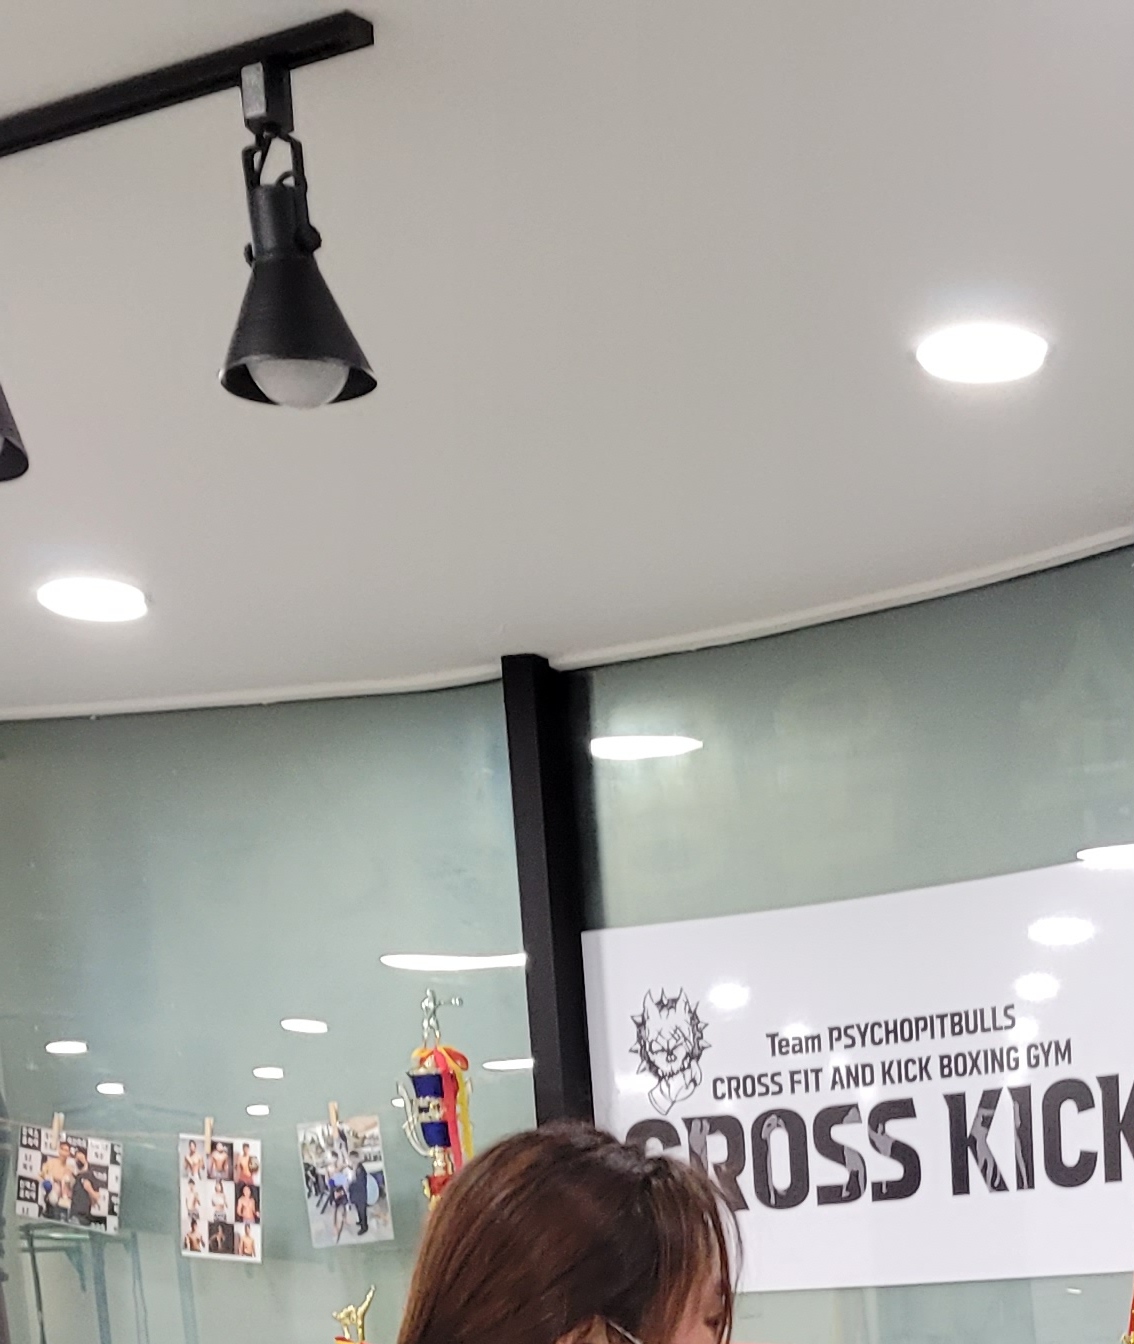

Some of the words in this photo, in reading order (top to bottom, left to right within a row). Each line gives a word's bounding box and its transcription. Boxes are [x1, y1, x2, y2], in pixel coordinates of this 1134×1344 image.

[766, 1031, 822, 1057] Team
[828, 1004, 1017, 1051] PSYCHOPITBULLS
[711, 1070, 784, 1101] CROSS
[789, 1069, 824, 1096] FIT
[830, 1062, 875, 1090] AND
[881, 1056, 932, 1087] KICK
[939, 1046, 1021, 1079] BOXING
[1026, 1038, 1073, 1069] GYM
